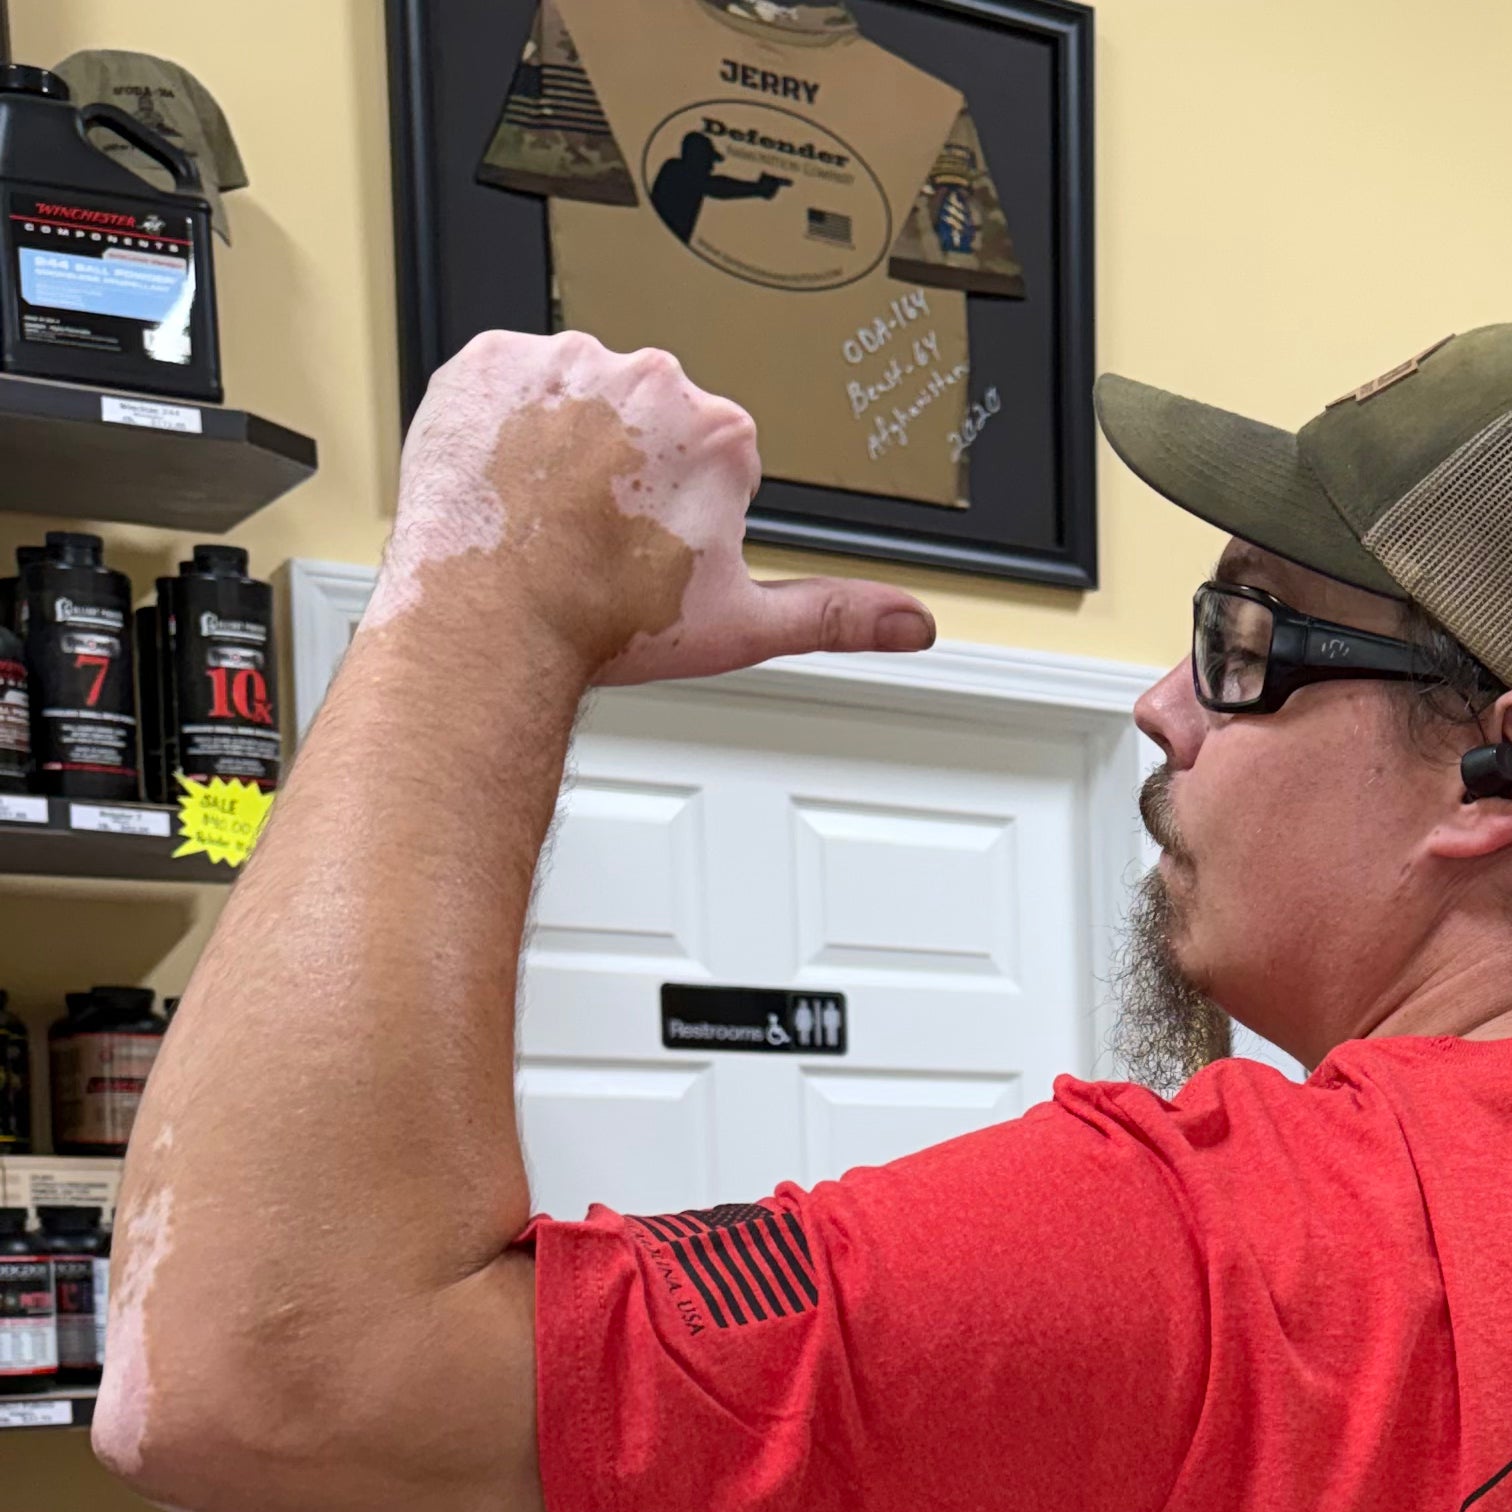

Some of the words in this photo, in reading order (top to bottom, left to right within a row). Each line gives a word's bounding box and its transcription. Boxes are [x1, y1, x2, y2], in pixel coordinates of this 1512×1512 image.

[720, 59, 820, 104] JERRY
[702, 117, 850, 168] Defender
[35, 202, 136, 228] WINCHESTER
[24, 222, 180, 253] COMPONENTS
[947, 387, 1001, 463] 2020
[74, 653, 110, 706] 7
[200, 794, 238, 815] SALE
[669, 1018, 765, 1043] Restrooms
[677, 1300, 705, 1337] USA
